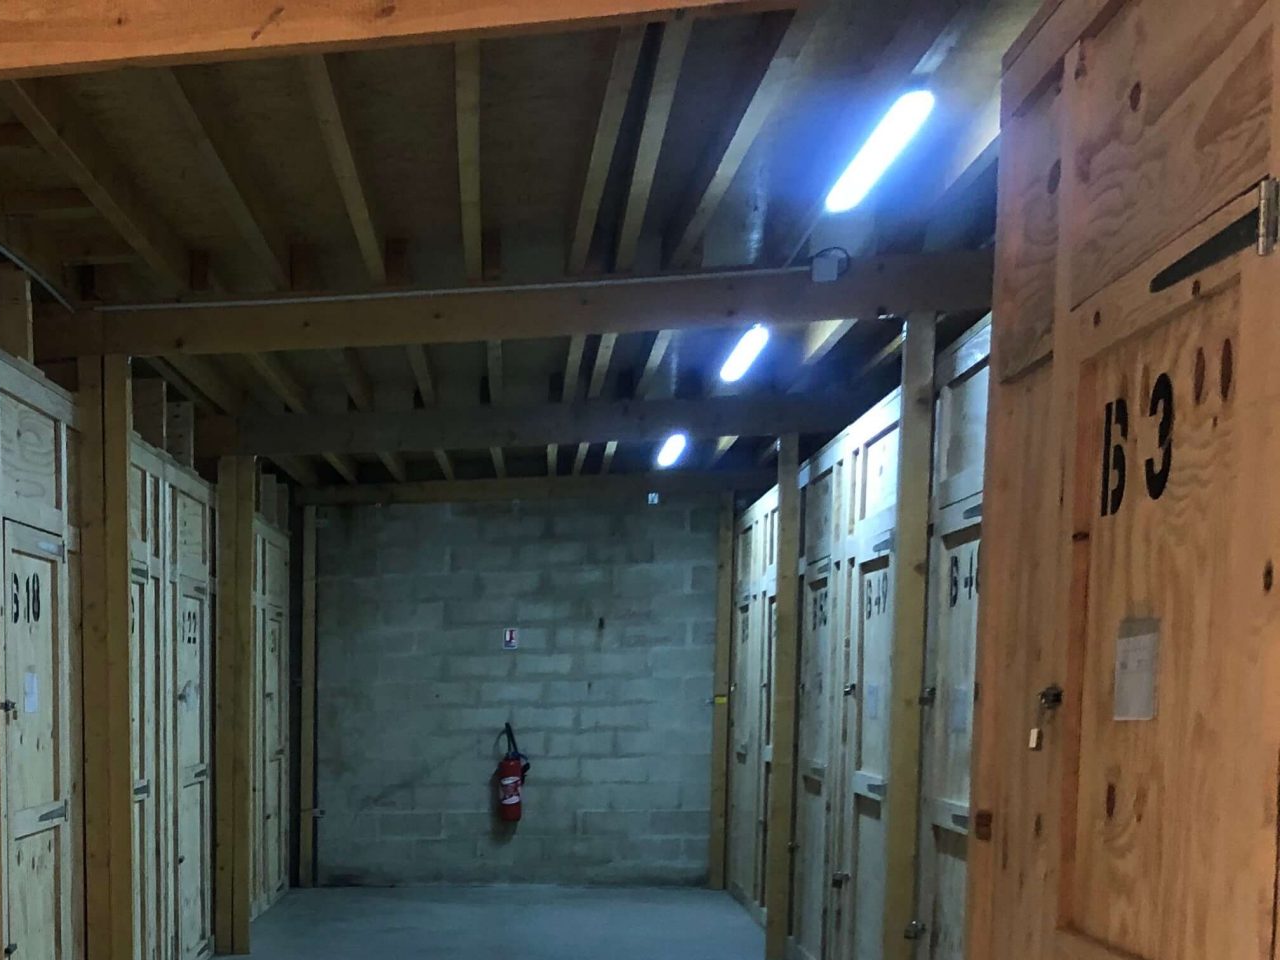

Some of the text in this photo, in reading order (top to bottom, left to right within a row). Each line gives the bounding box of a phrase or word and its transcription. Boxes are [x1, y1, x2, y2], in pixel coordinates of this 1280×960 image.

[1101, 373, 1175, 517] B 3
[11, 572, 41, 624] B 18
[865, 572, 888, 620] B 49
[949, 556, 959, 608] B
